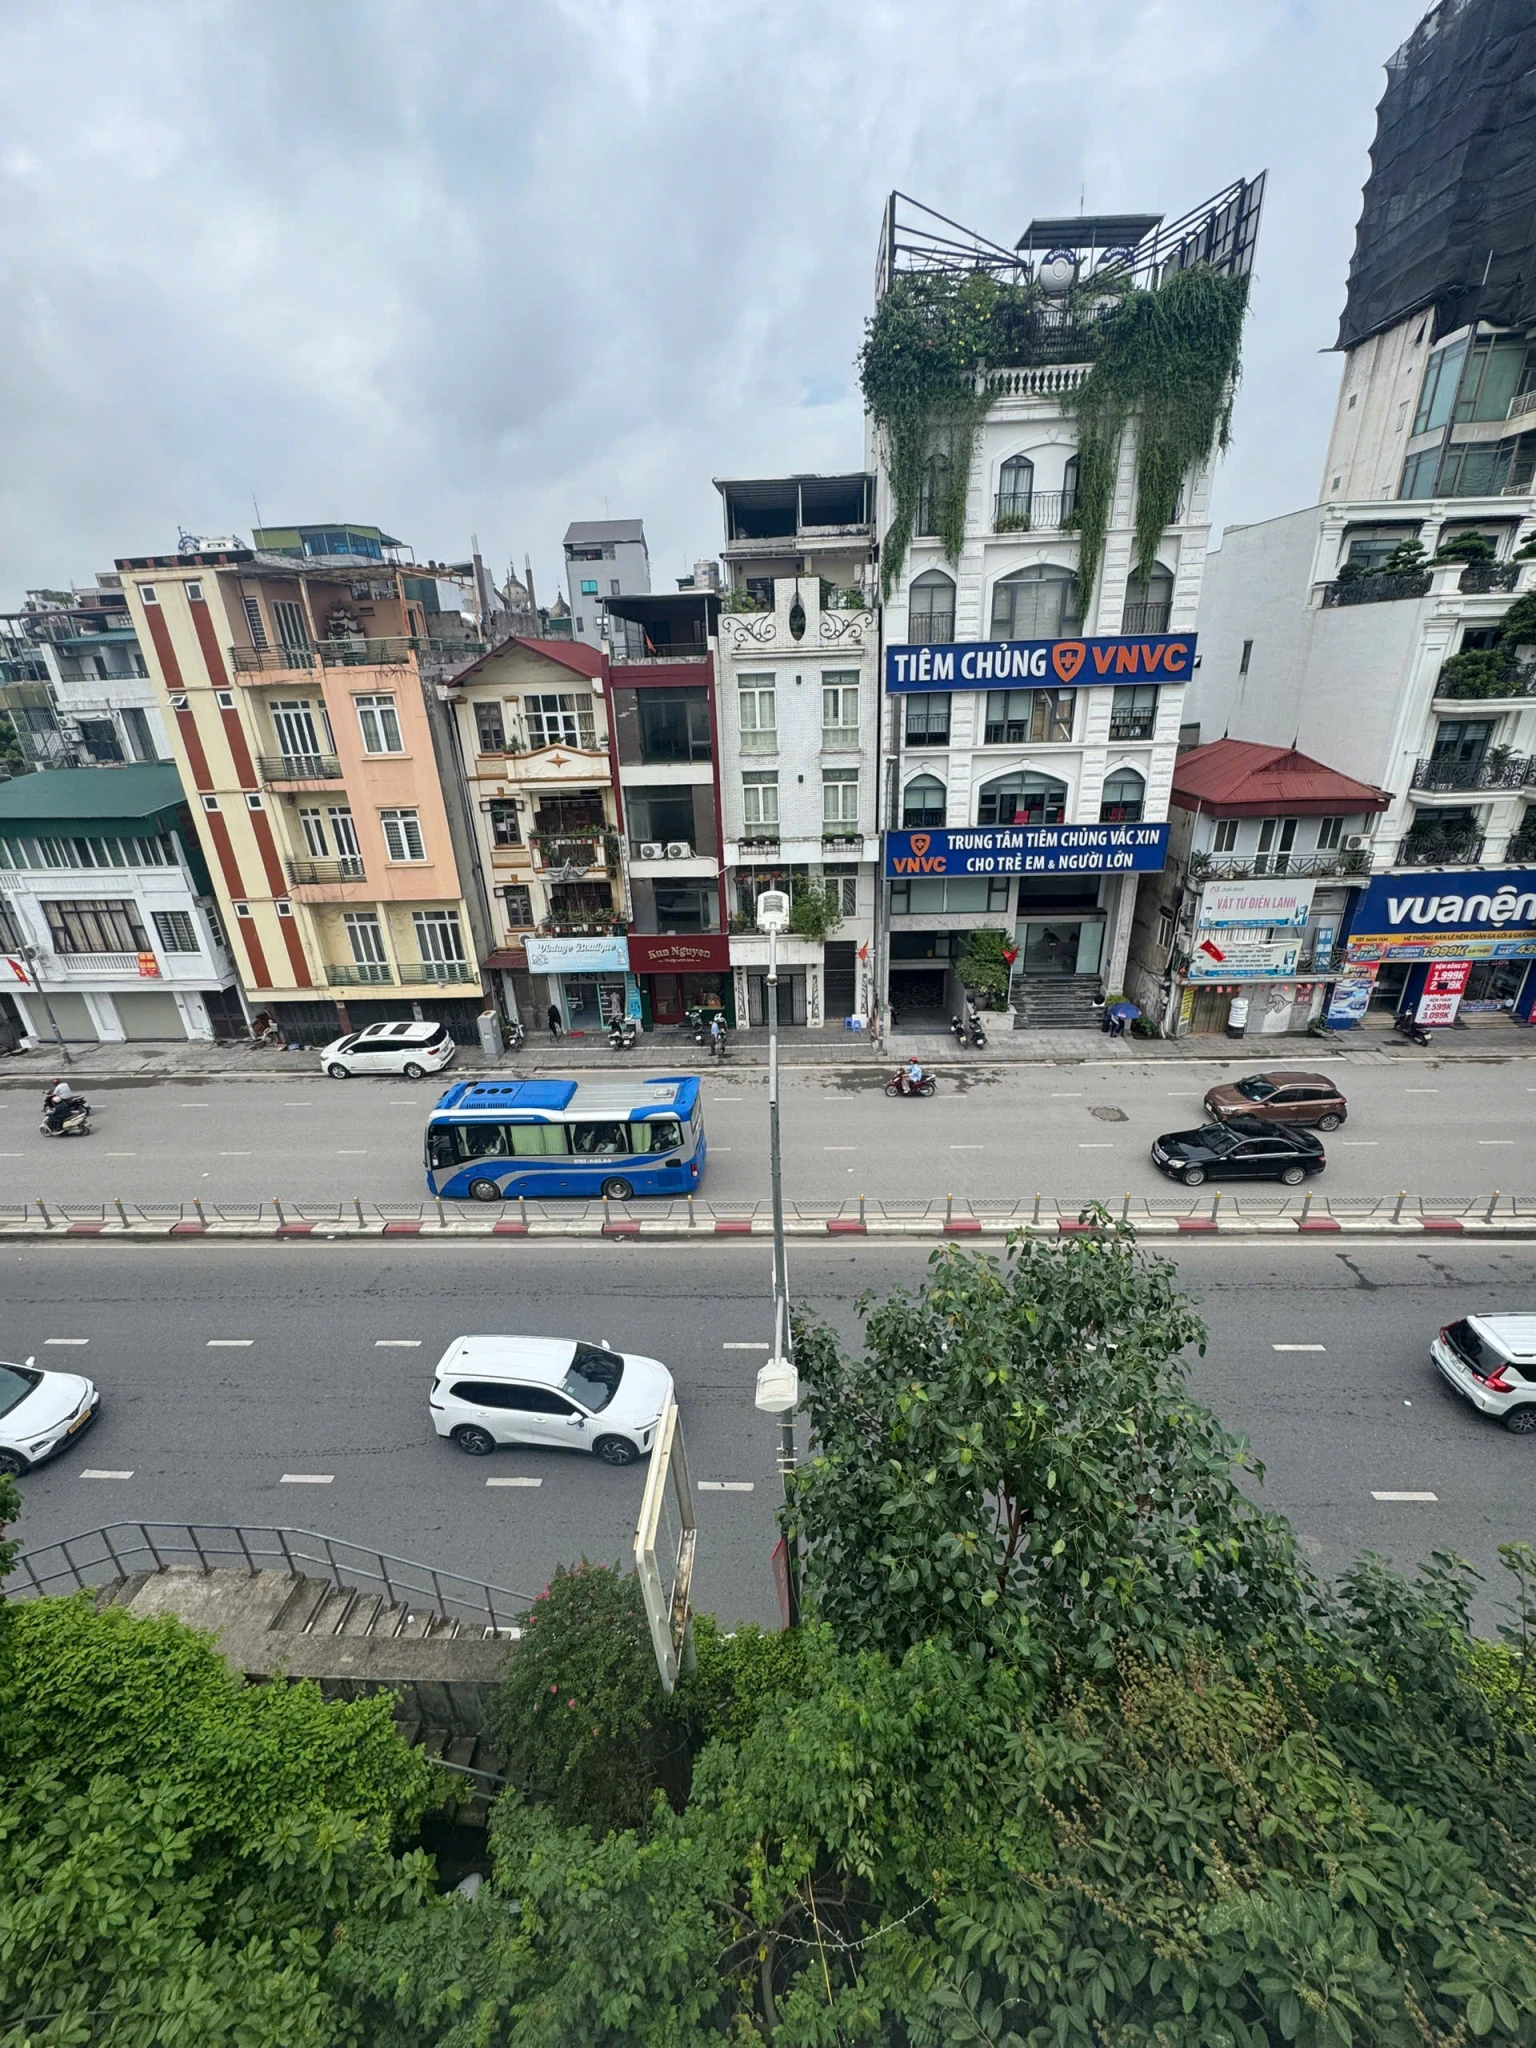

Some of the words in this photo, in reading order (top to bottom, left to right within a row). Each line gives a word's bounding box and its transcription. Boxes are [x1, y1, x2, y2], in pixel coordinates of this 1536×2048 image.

[894, 648, 954, 682] TIÊM
[961, 643, 1048, 679] CHỦNG
[1092, 643, 1188, 675] VNVC
[948, 835, 992, 850] TRUNG
[995, 831, 1023, 849] TÂM
[1026, 829, 1058, 848] TIÊM
[1061, 827, 1107, 846] CHỦNG
[1110, 825, 1134, 845] VẮC
[1135, 830, 1160, 844] XIN
[893, 856, 946, 873] VNVC
[966, 857, 994, 872] CHO
[997, 854, 1022, 870] TRẺ
[1025, 856, 1045, 870] EM
[1048, 860, 1055, 869] &
[1058, 850, 1103, 870] NGƯỜI
[1106, 850, 1133, 868] LỚN
[1217, 896, 1235, 912] VẬT
[1236, 897, 1249, 910] TƯ
[1249, 895, 1271, 911] ĐIỆN
[1272, 896, 1297, 911] LẠNH
[1423, 944, 1468, 957] 1.999K
[1516, 944, 1536, 955] 43
[1432, 970, 1466, 980] 1.999K
[1424, 1003, 1452, 1011] 2.599K
